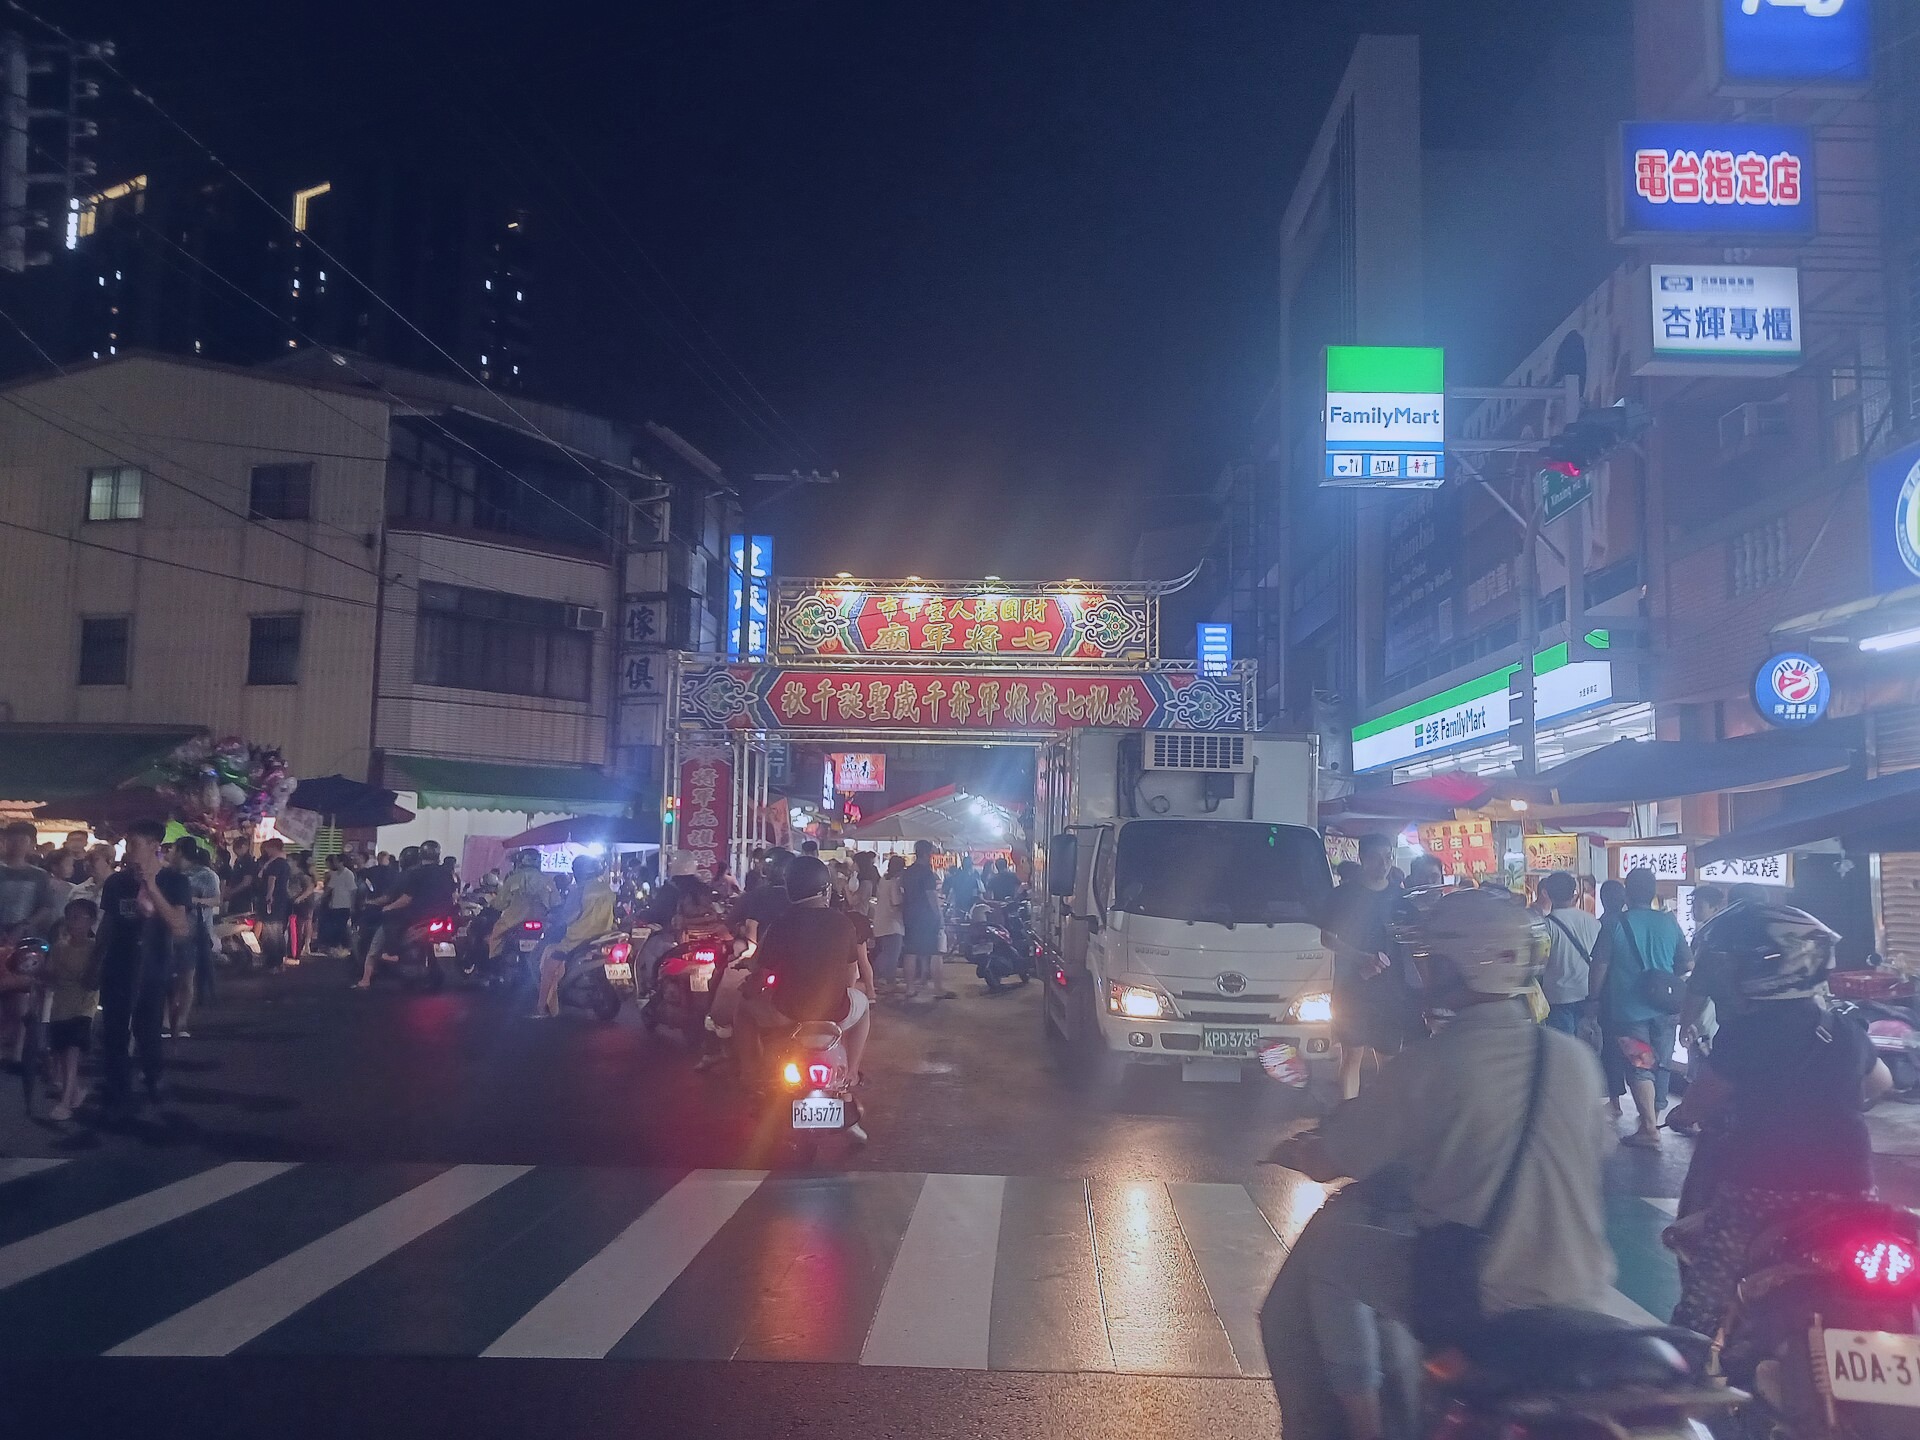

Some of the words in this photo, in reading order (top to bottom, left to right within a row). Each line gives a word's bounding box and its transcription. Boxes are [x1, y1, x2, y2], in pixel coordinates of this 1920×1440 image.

[1636, 150, 1800, 205] 電台指定店
[1662, 305, 1793, 341] 杏輝專櫃
[1330, 406, 1440, 428] FamilyMart
[1375, 460, 1394, 473] ATM
[870, 622, 1053, 652] 七將軍廟
[1425, 720, 1439, 745] 全家
[1441, 705, 1486, 740] FamilyMart
[1630, 853, 1679, 875] 日式大阪燒
[793, 1106, 842, 1122] PGJ-5777
[1834, 1349, 1920, 1387] ADA-3
